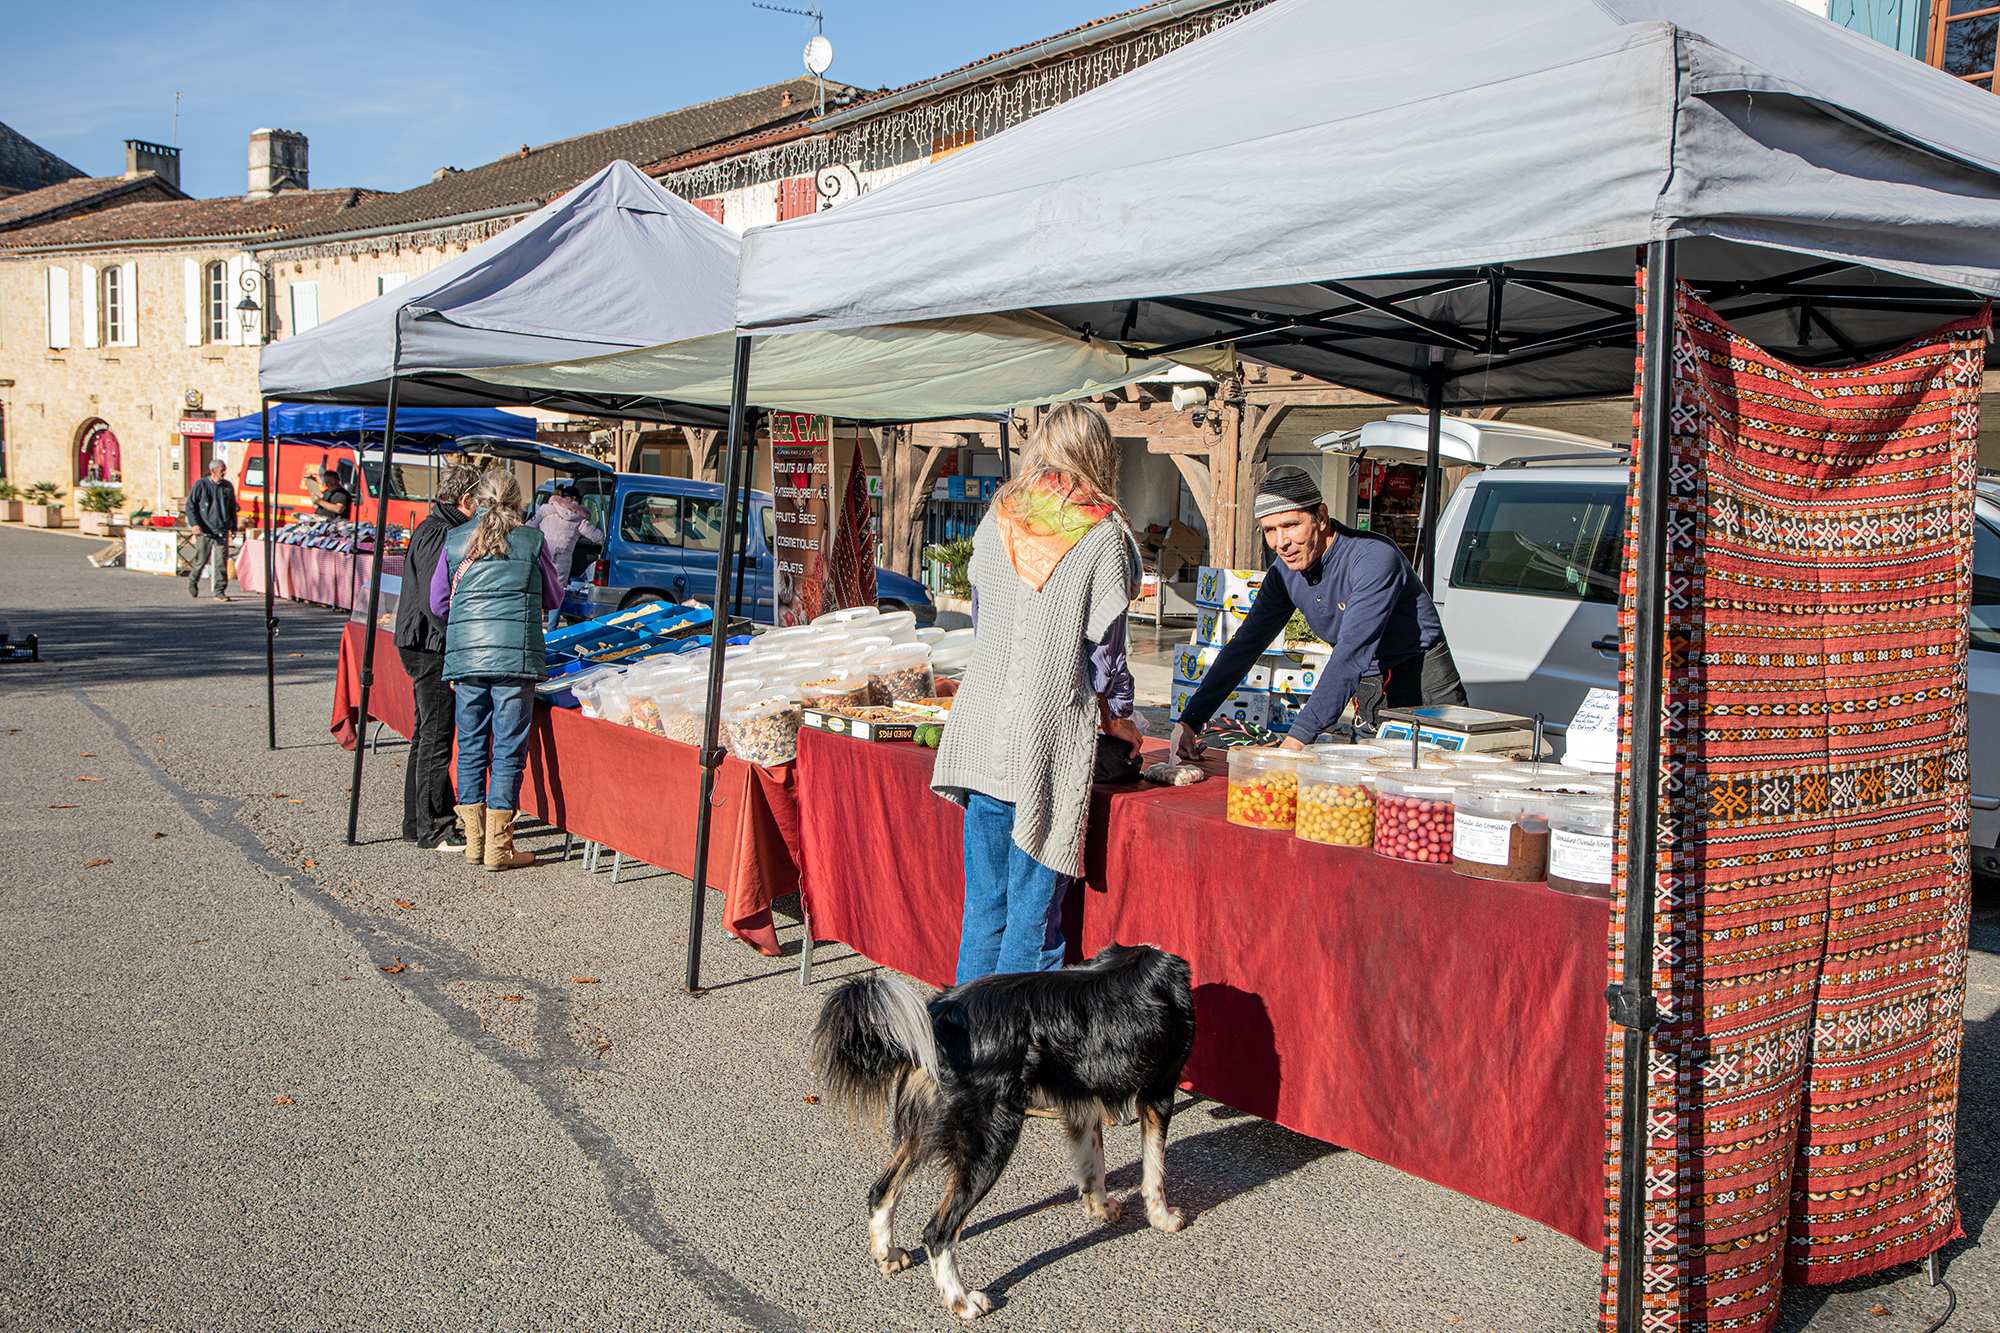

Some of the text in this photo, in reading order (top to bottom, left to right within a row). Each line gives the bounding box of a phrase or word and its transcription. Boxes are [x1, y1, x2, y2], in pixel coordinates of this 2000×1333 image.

[180, 420, 215, 434] EXPOSITION
[796, 462, 806, 474] DU
[806, 462, 827, 474] MAROC
[775, 511, 817, 525] FRUITS SECS
[777, 535, 819, 551] COSMETIQUES
[779, 560, 804, 575] OBJETS
[878, 729, 913, 739] DRIED FIGS
